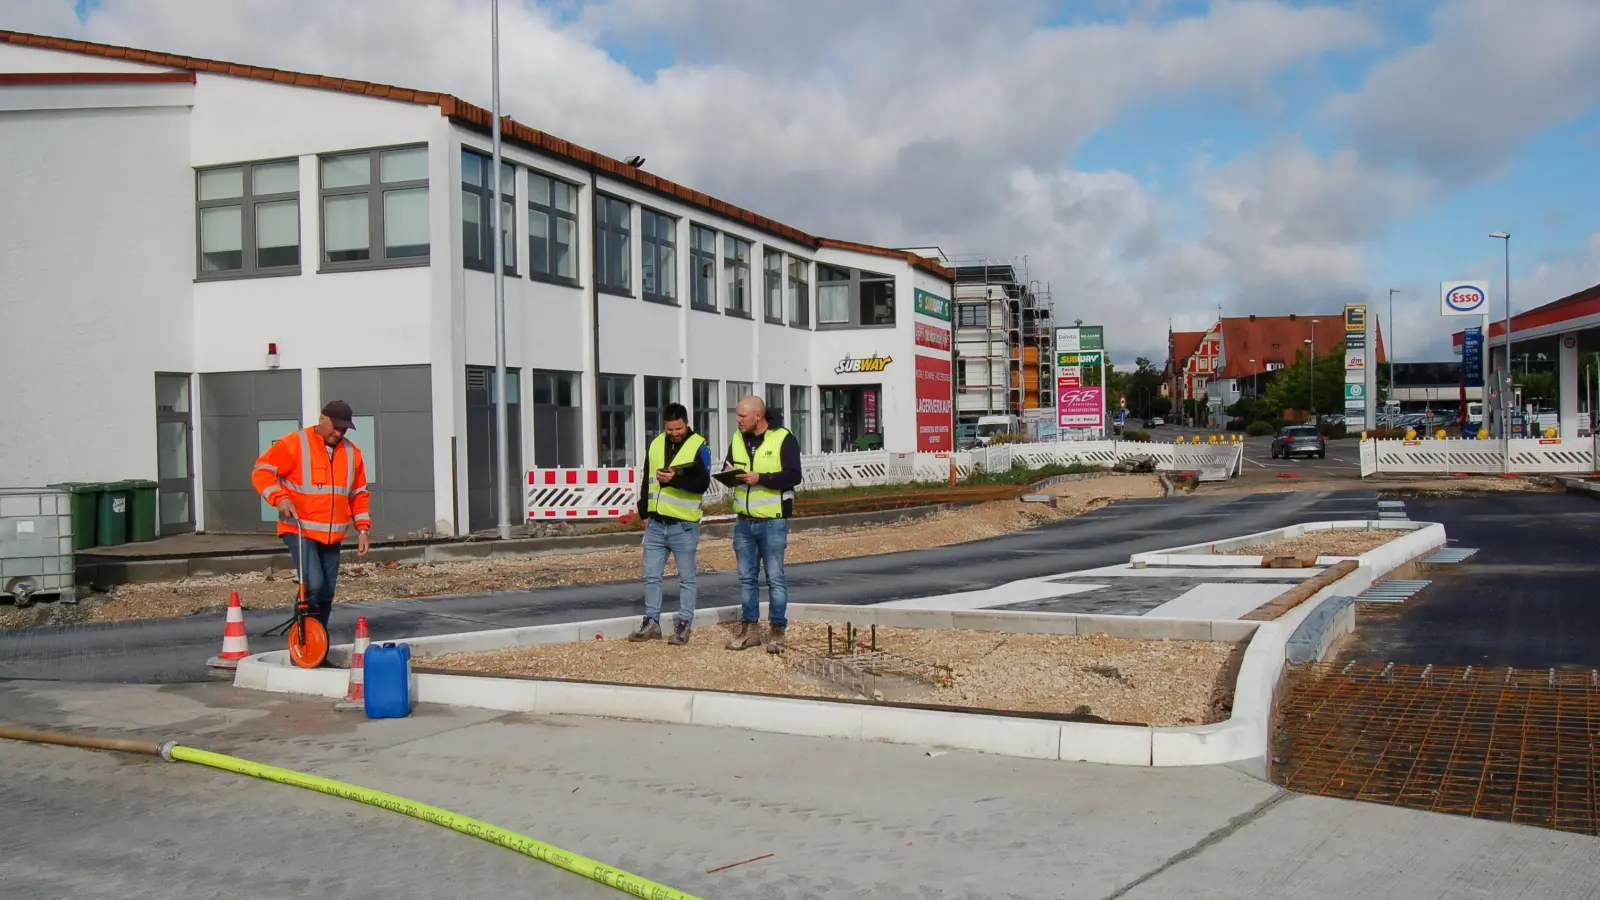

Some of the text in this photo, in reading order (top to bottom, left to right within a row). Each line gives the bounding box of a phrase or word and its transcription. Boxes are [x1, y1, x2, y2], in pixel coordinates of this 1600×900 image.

[1452, 292, 1479, 303] Esso
[834, 355, 893, 375] SUBWAY
[1061, 355, 1099, 364] SUBWAY
[916, 398, 952, 413] LAGERVERKAUF
[615, 874, 646, 897] Ernst
